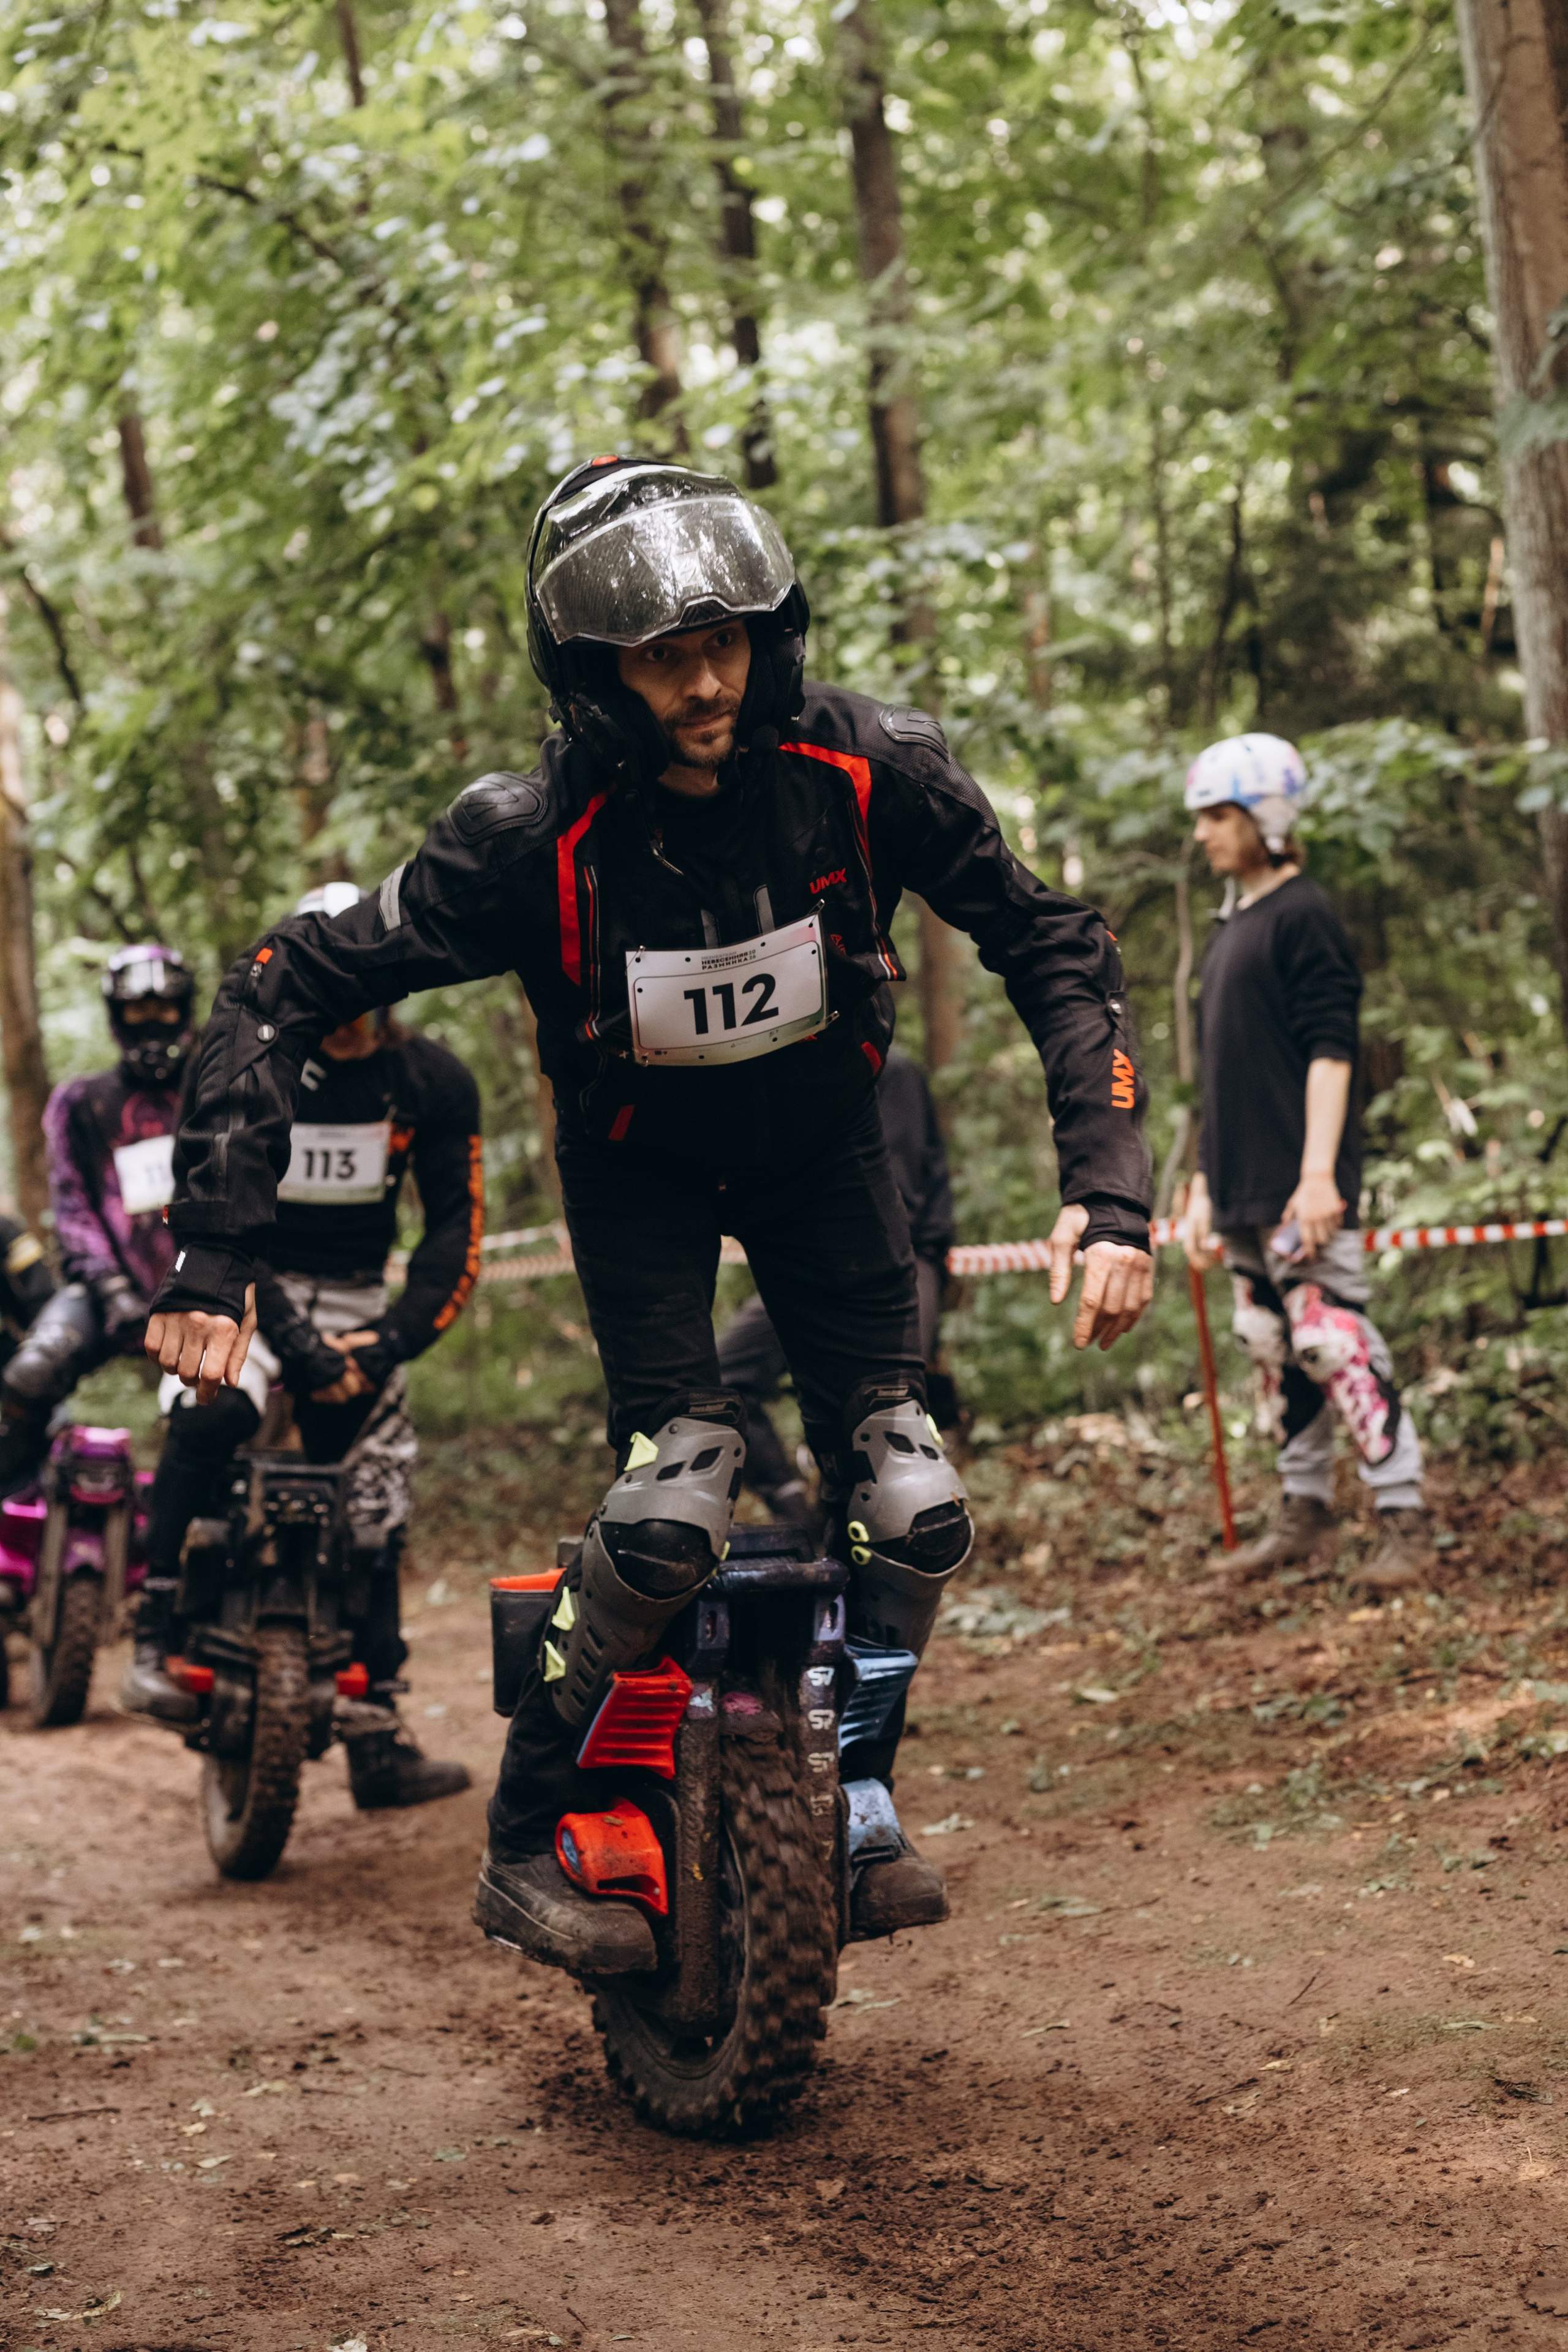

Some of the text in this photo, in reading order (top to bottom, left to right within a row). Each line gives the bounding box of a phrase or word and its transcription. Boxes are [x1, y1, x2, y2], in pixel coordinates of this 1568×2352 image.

[810, 867, 846, 894] UMX
[684, 973, 779, 1035] 112
[303, 1147, 356, 1180] 113
